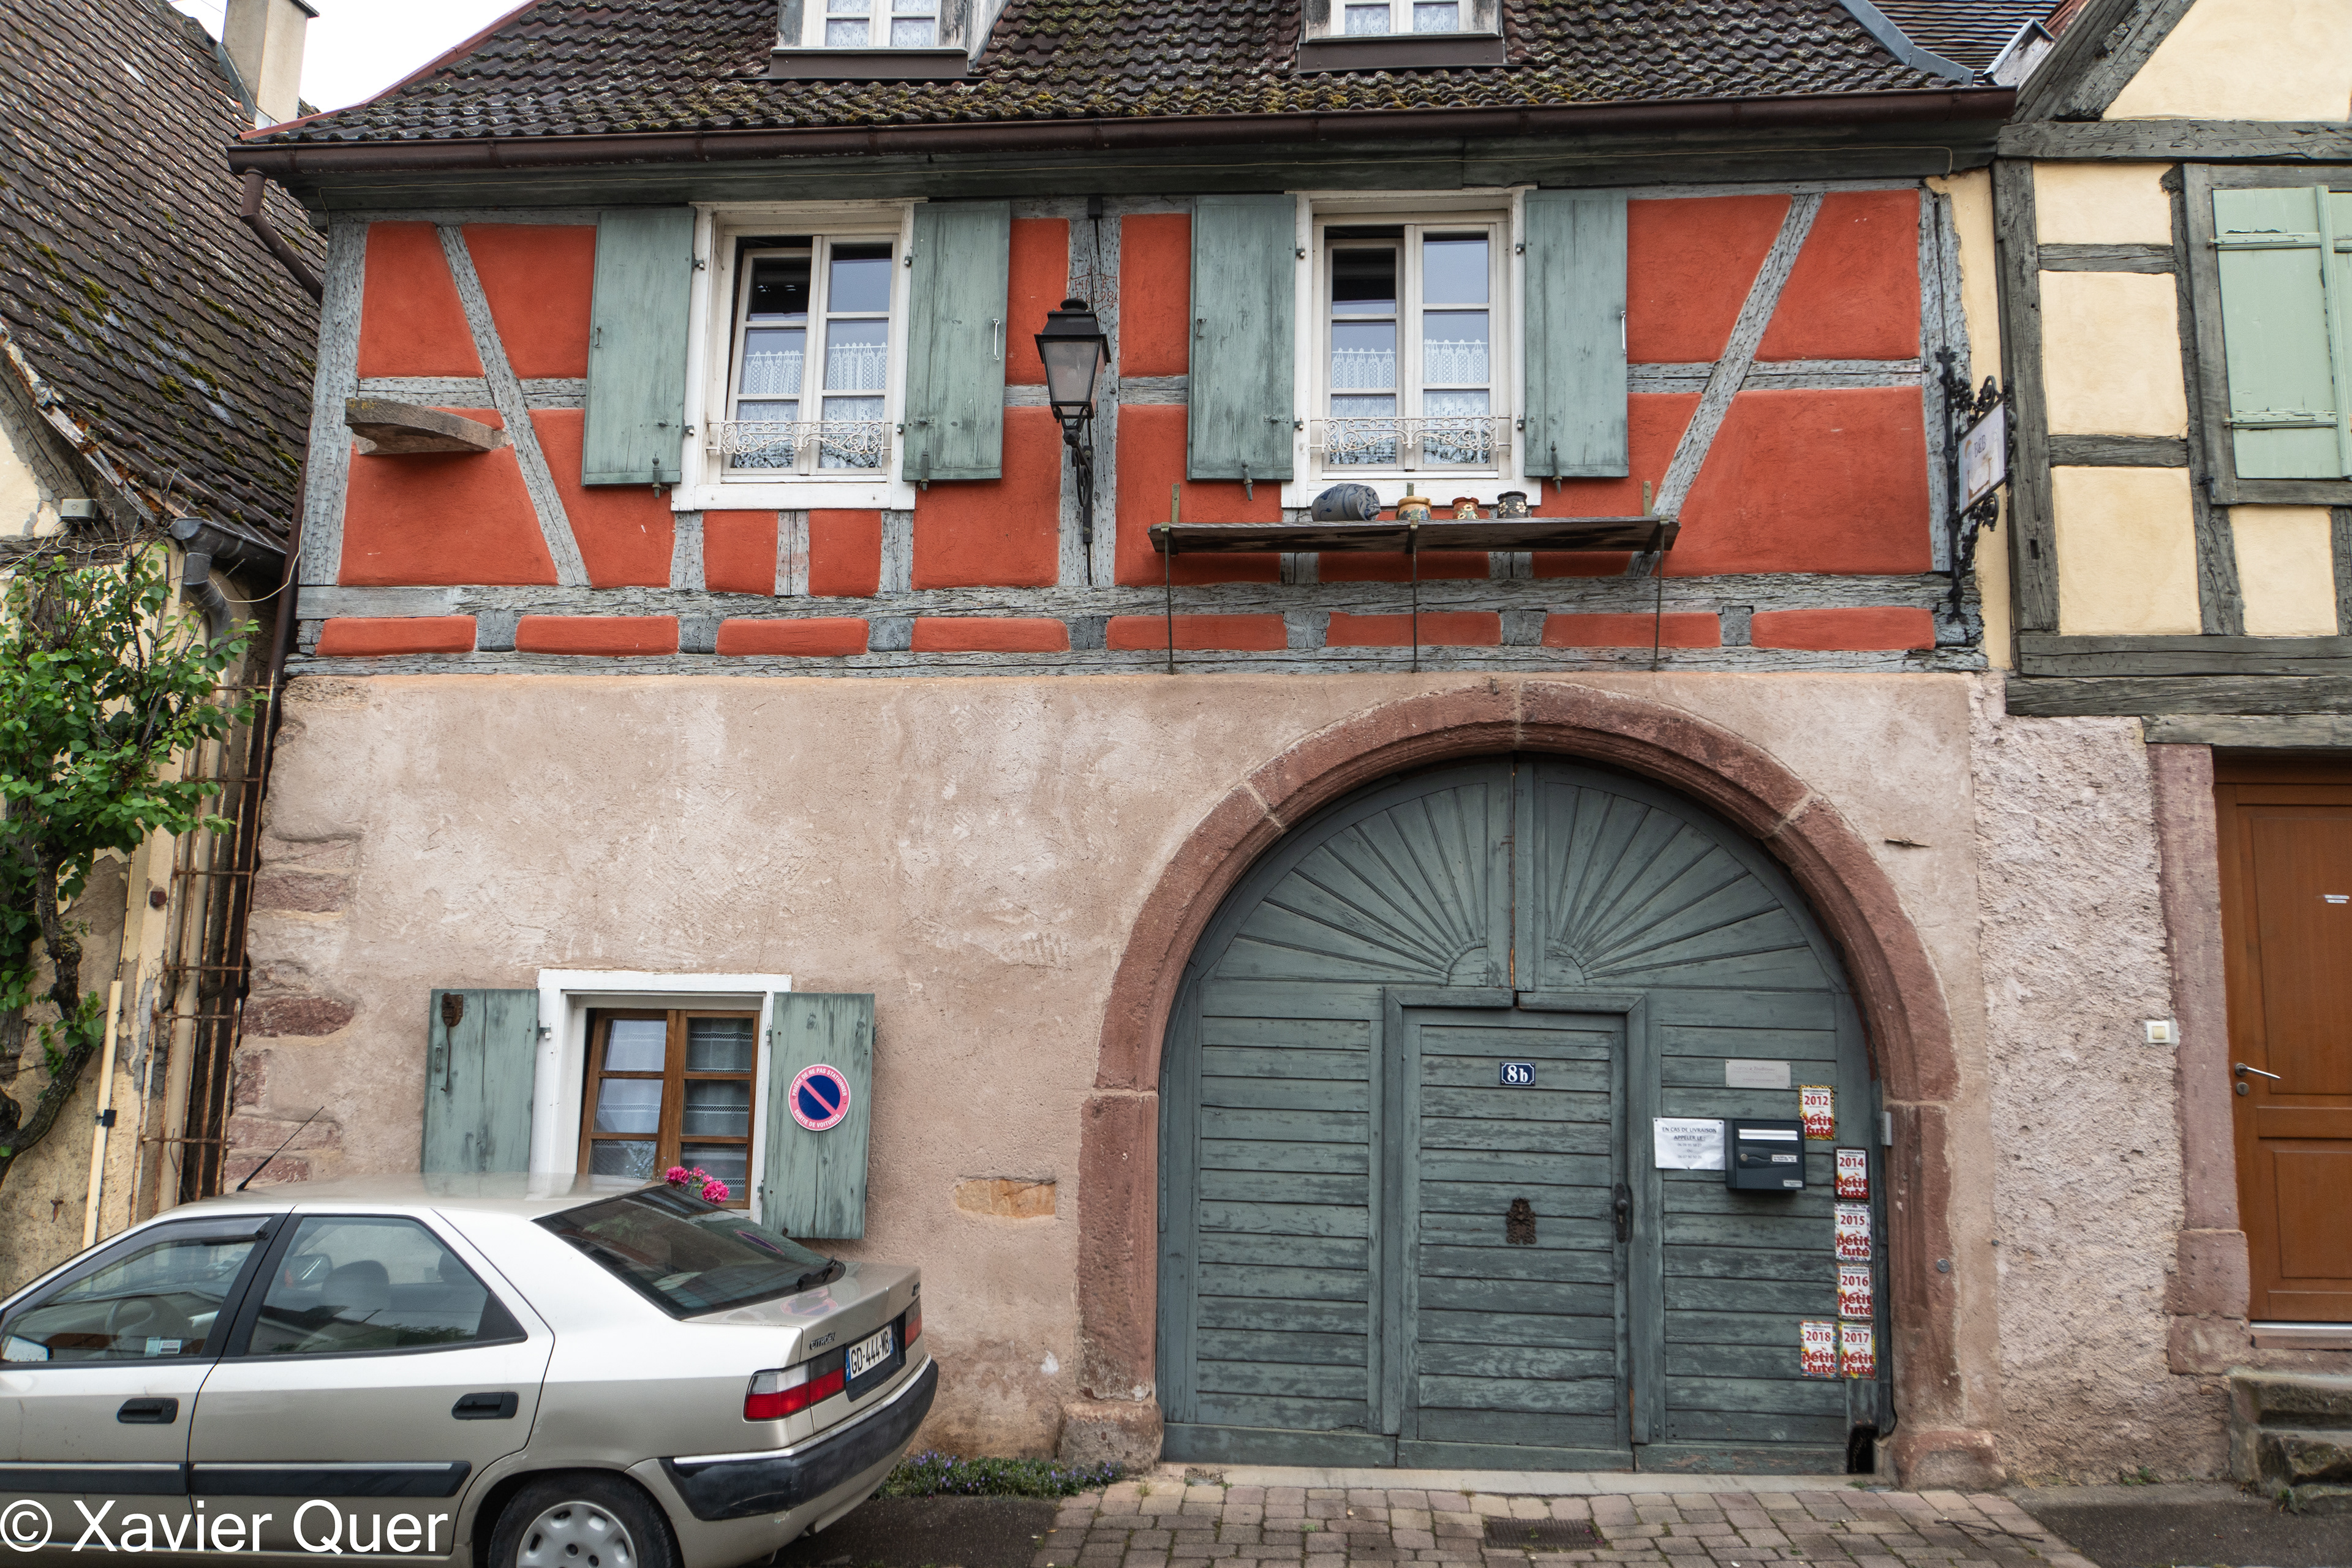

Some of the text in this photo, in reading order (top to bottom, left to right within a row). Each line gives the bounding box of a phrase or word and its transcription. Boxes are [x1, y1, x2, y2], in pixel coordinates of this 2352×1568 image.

[1974, 434, 1986, 458] B&B
[1507, 1065, 1529, 1083] 8b
[792, 1077, 802, 1096] PRIÈRE
[826, 1069, 847, 1096] STATIONNER
[1804, 1095, 1829, 1106] 2012
[794, 1109, 809, 1125] SORTIE
[816, 1113, 840, 1128] VOITURES
[1806, 1125, 1834, 1136] futé
[1839, 1156, 1864, 1167] 2014
[1841, 1187, 1869, 1199] futé
[1841, 1215, 1865, 1226] 2015
[1842, 1245, 1869, 1257] futé
[1842, 1275, 1869, 1286] 2016
[1844, 1304, 1872, 1315] futé
[1806, 1330, 1831, 1341] 2018
[1844, 1332, 1870, 1343] 2017
[1807, 1362, 1836, 1374] futé
[1847, 1363, 1875, 1375] futé
